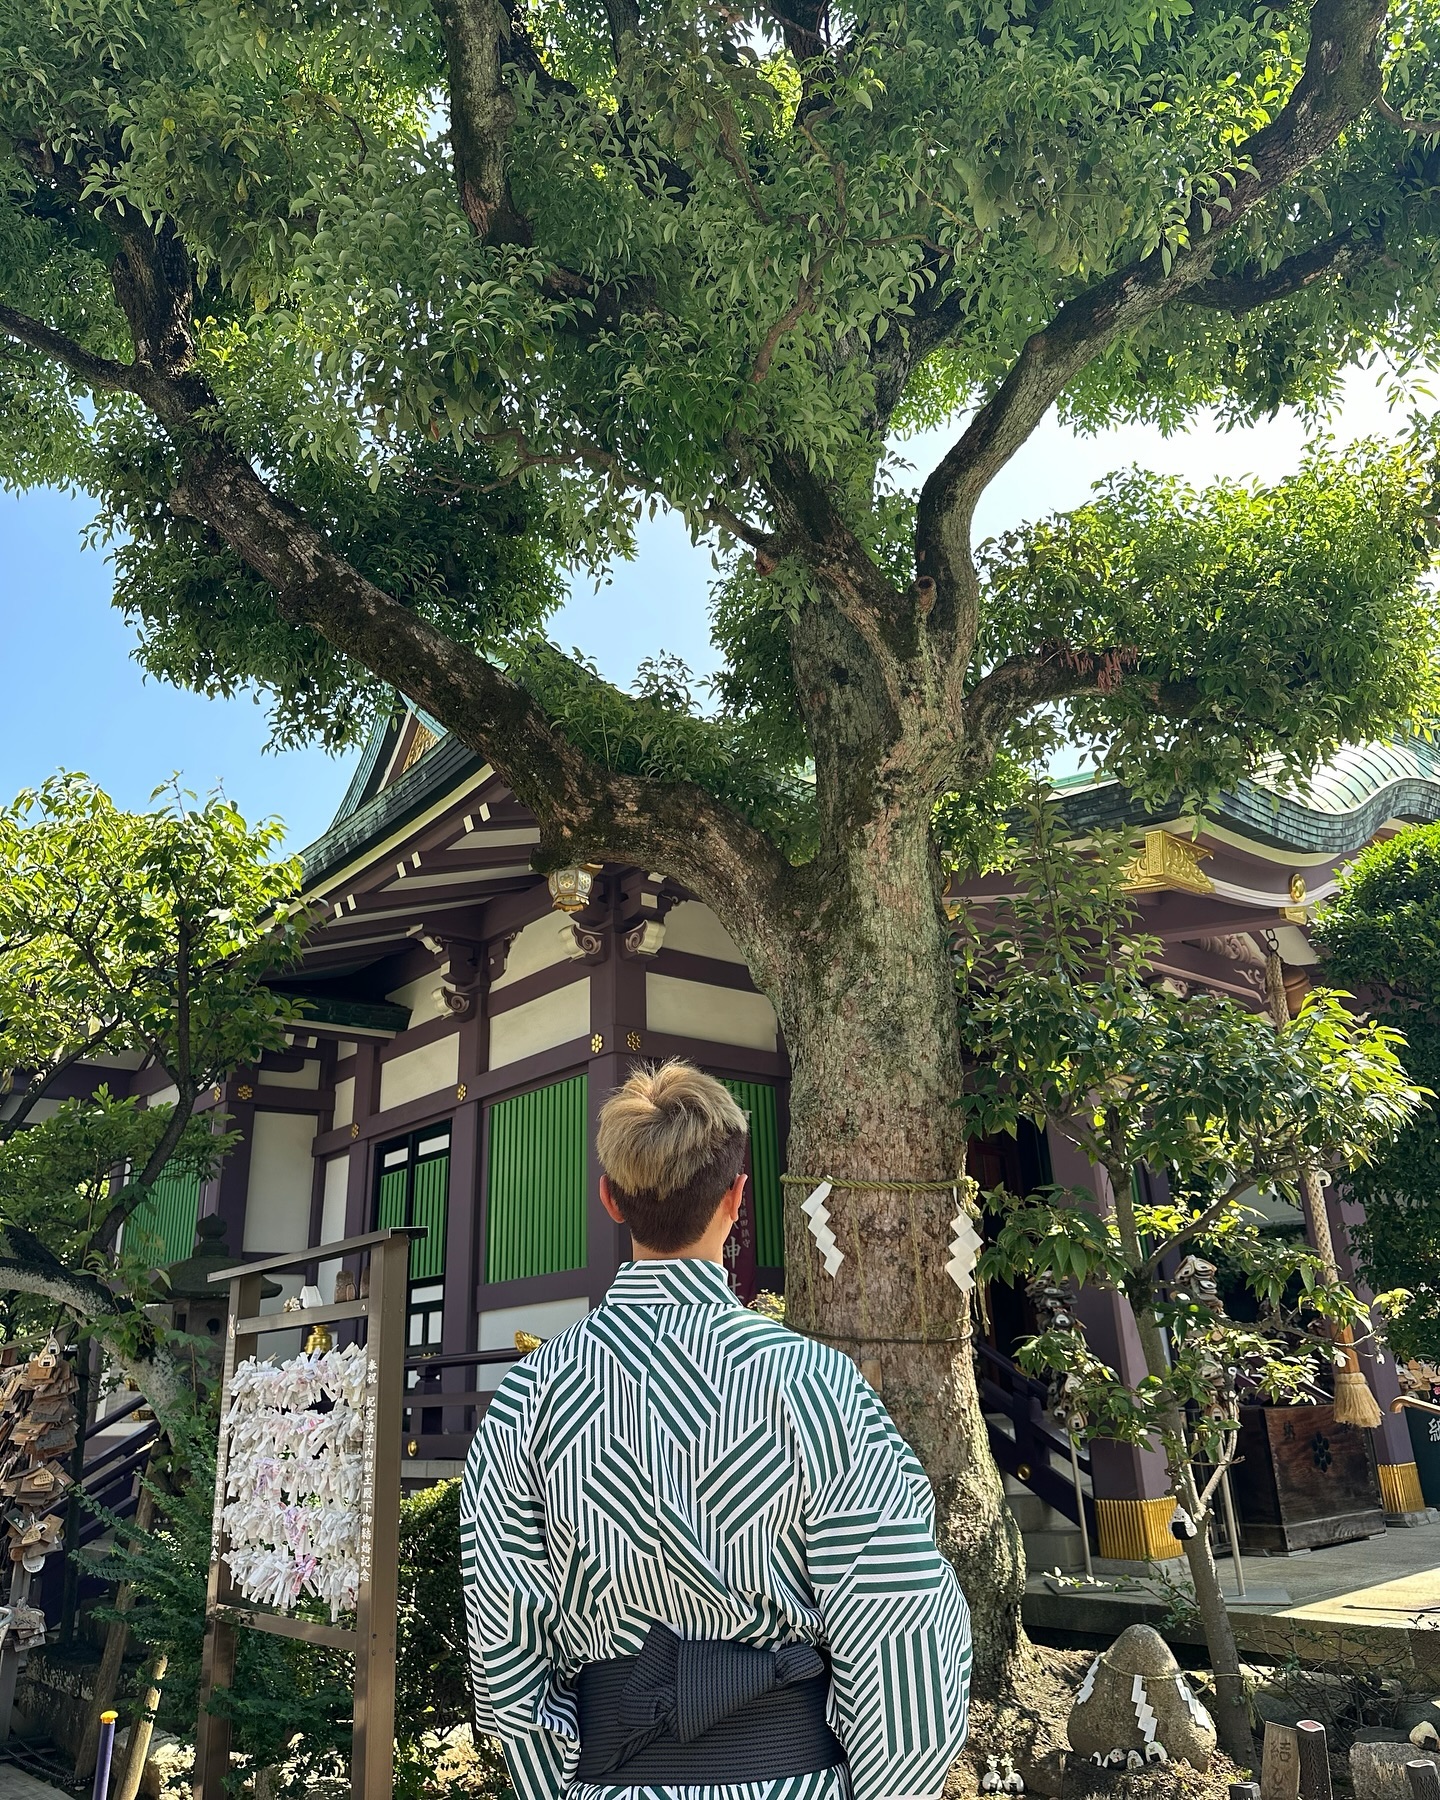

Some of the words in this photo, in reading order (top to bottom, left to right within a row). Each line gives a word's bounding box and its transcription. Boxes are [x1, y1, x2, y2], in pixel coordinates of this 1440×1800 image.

[366, 1359, 378, 1384] 奉祝
[360, 1396, 376, 1582] 紀宮清子内親王殿下御結婚記念
